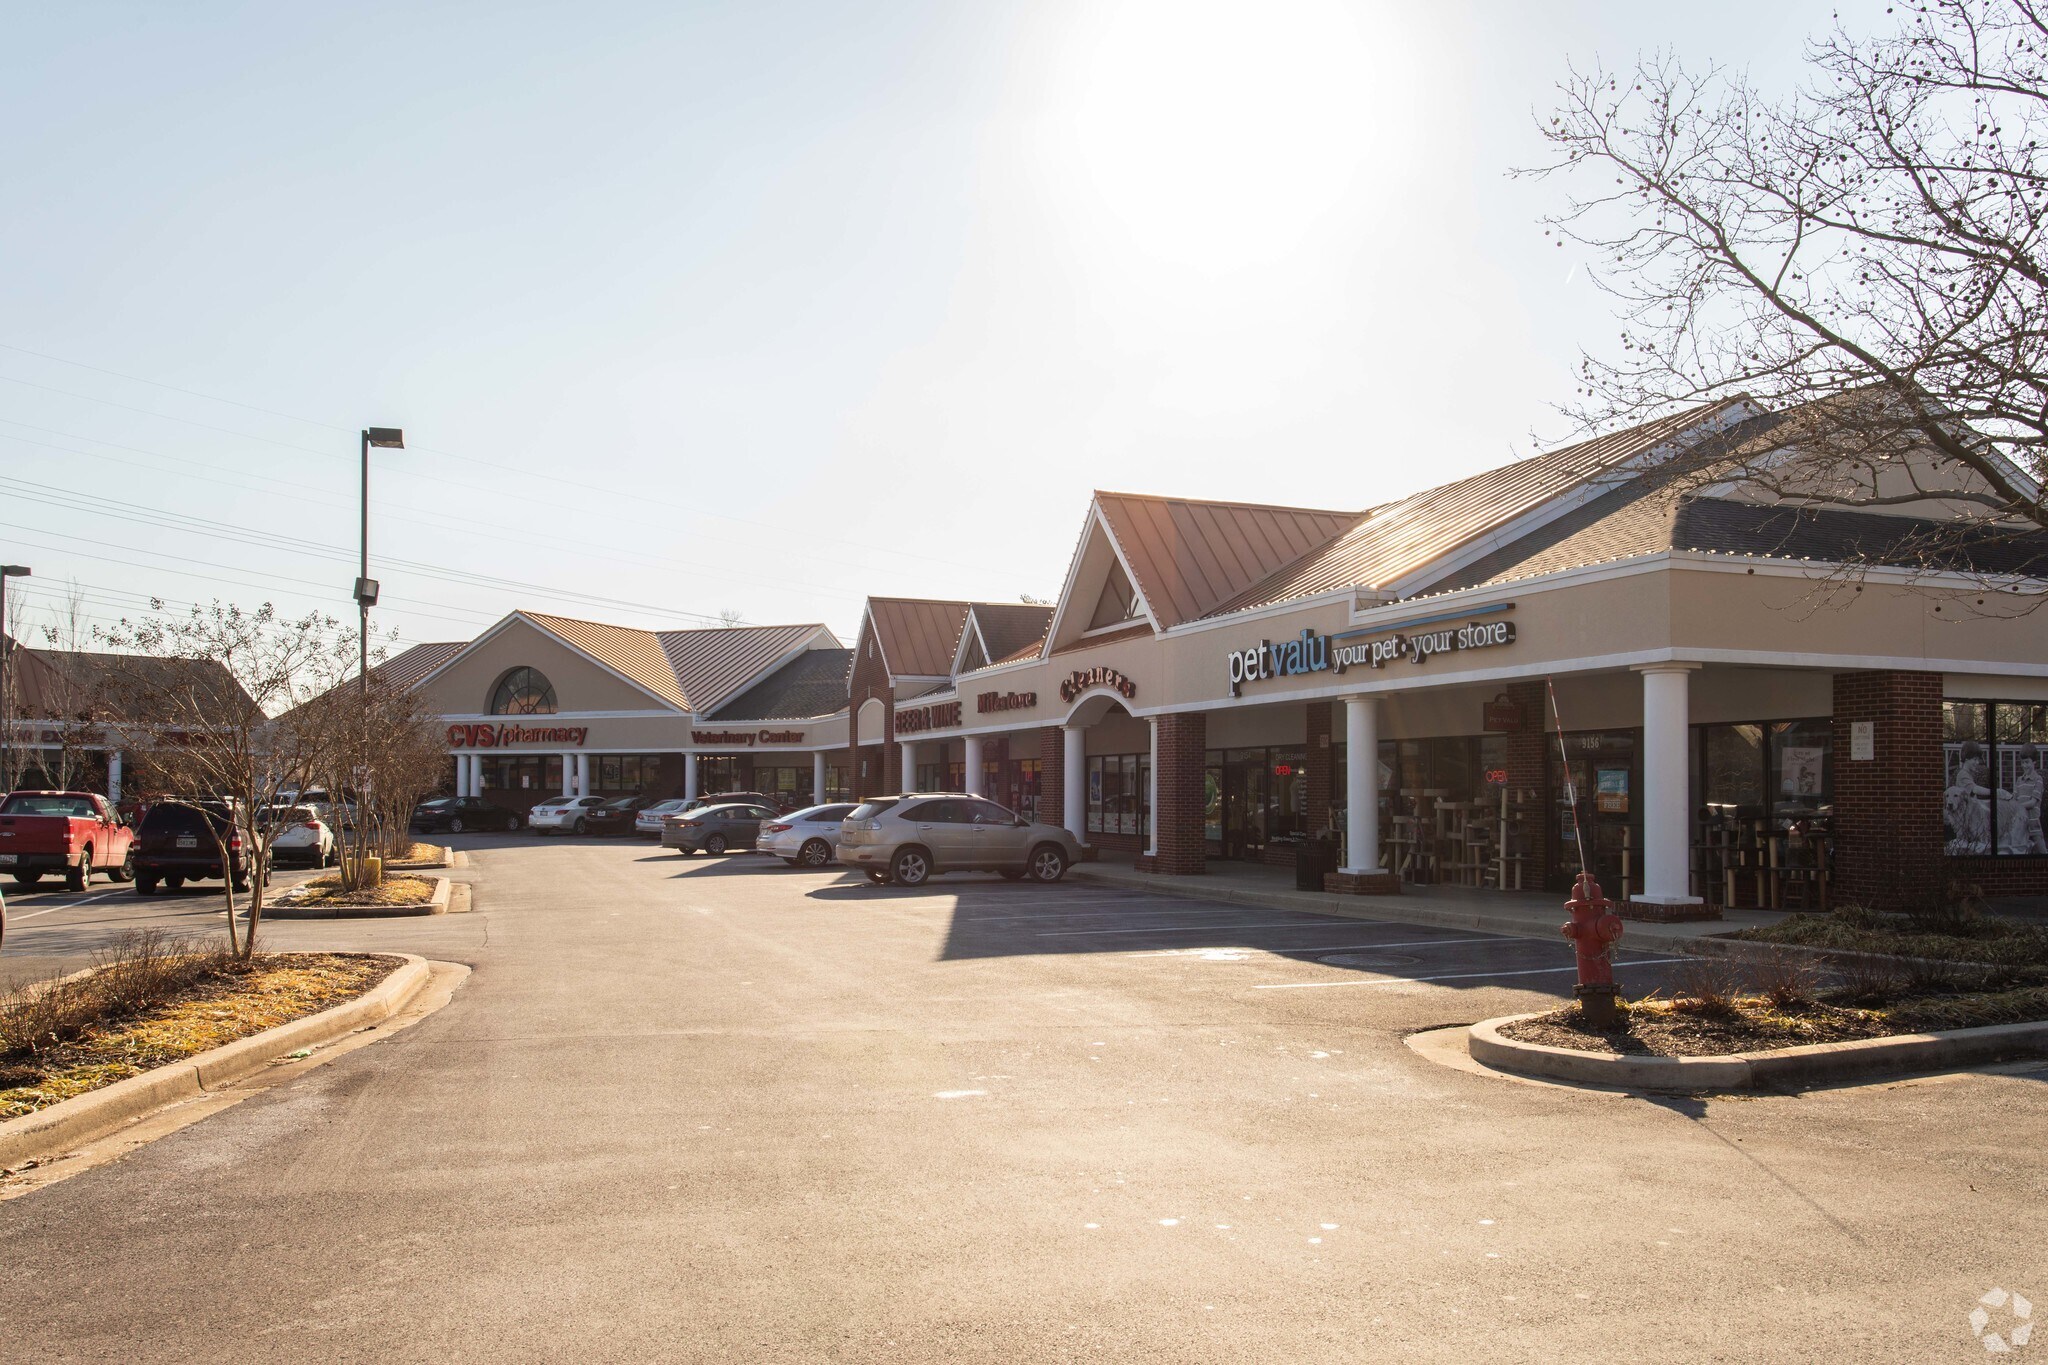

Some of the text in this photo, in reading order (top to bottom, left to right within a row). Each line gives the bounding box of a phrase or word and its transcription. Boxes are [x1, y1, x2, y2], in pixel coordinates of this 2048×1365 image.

[1228, 621, 1508, 697] pet valu your pet your store
[1060, 666, 1136, 703] Cleaners
[977, 691, 1037, 713] Milestone
[895, 708, 922, 733] BEER
[931, 701, 962, 728] WINE
[691, 729, 805, 746] Veterinary Center
[1858, 726, 1868, 734] NO
[1582, 737, 1600, 749] 9156
